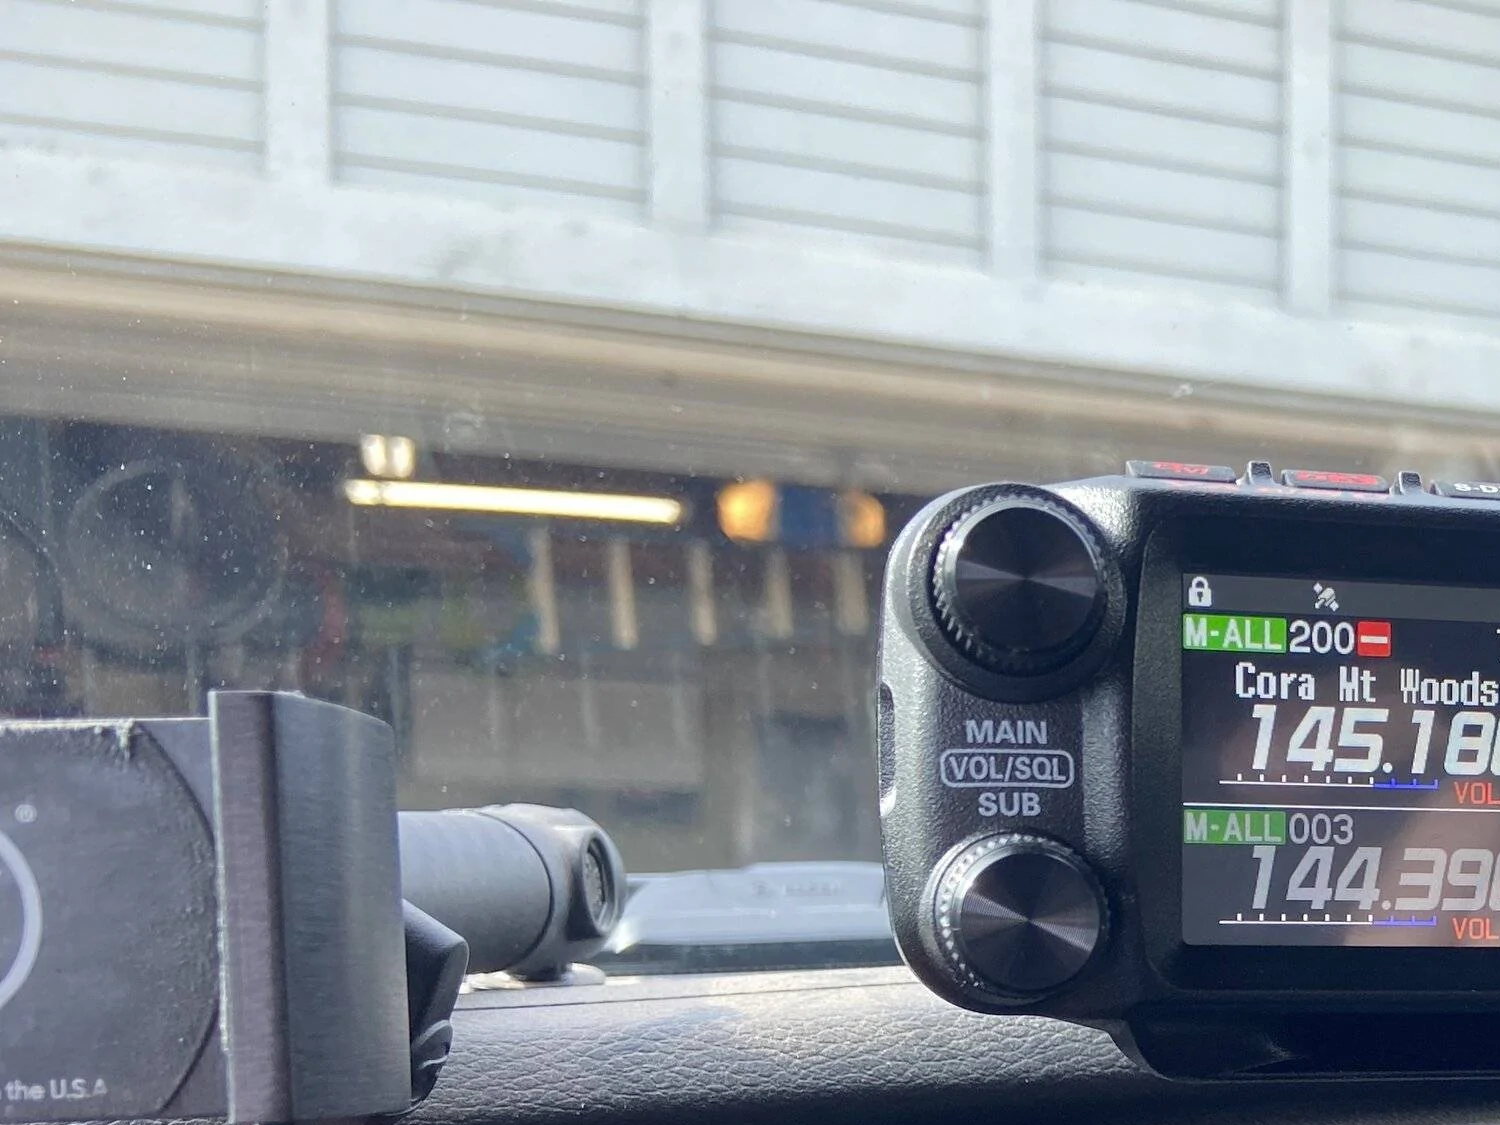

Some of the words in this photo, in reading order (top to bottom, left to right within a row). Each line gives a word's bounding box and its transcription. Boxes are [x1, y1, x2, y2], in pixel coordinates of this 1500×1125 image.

[1184, 617, 1282, 650] M-ALL
[1290, 620, 1354, 654] 200
[1236, 662, 1315, 700] Cora
[1340, 666, 1376, 702] Mt
[964, 719, 1047, 744] MAIN
[948, 753, 1067, 783] VOL/SQL
[978, 792, 1041, 816] SUB
[1184, 812, 1281, 843] M-ALL
[1289, 813, 1353, 847] 003
[1452, 918, 1499, 942] VOL
[5, 1078, 46, 1101] the
